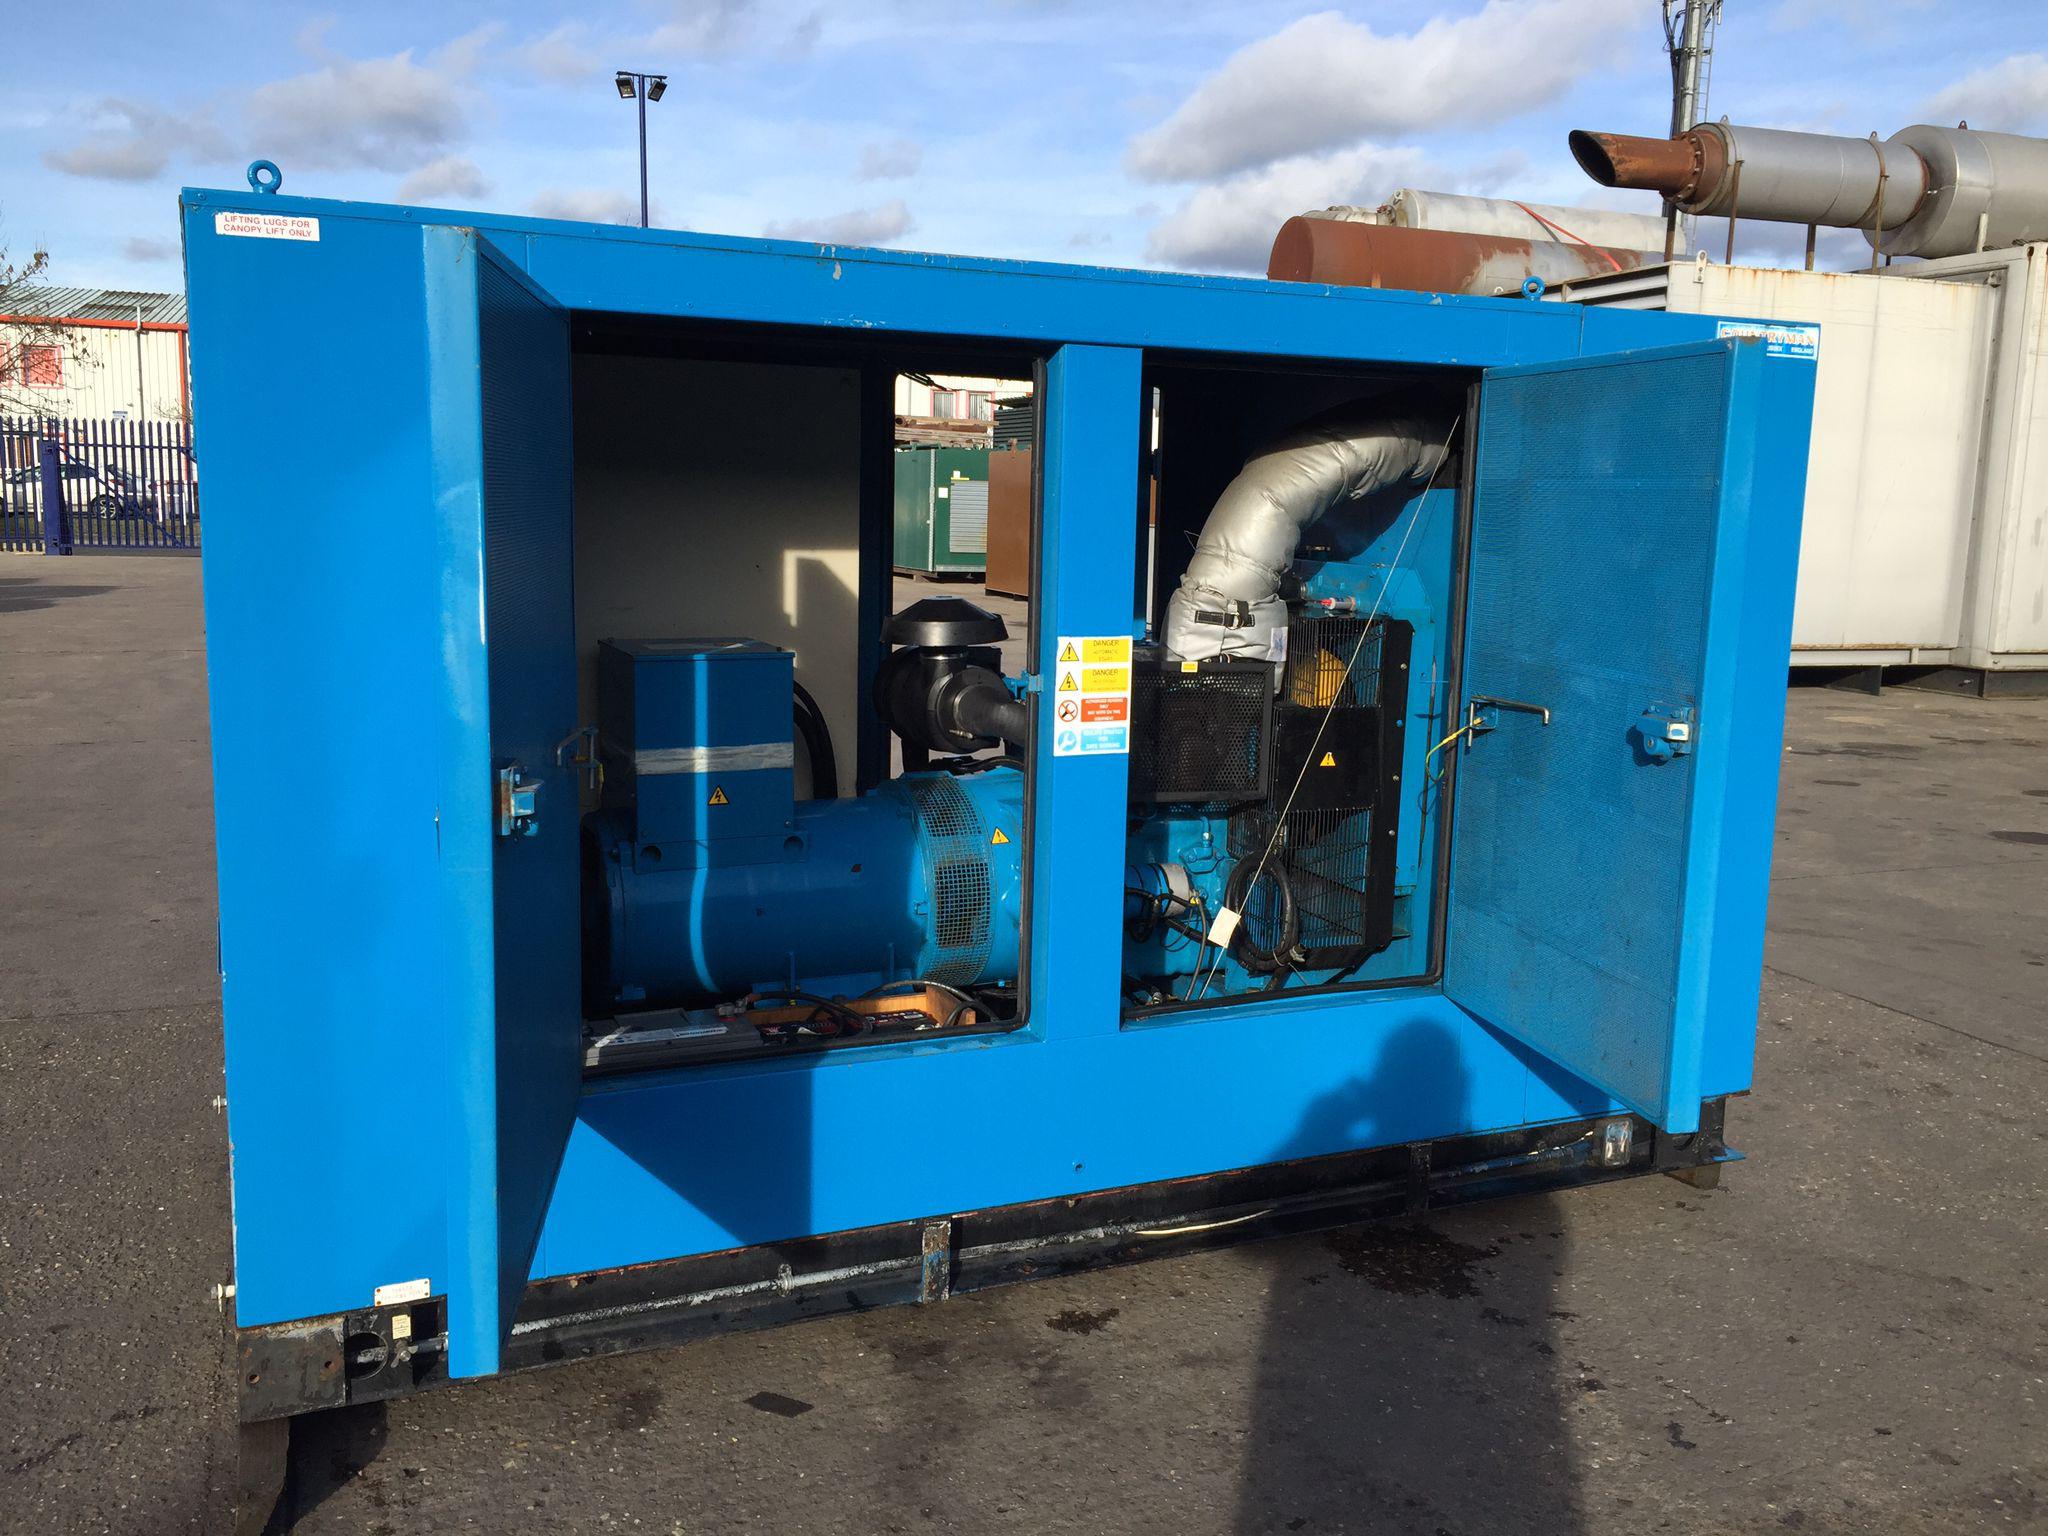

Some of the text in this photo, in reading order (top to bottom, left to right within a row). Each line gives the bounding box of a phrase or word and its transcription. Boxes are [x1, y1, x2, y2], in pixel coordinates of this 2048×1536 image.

[224, 215, 310, 228] LIFTING LUGS FOR
[223, 224, 312, 237] CANOPY LIFT ONLY
